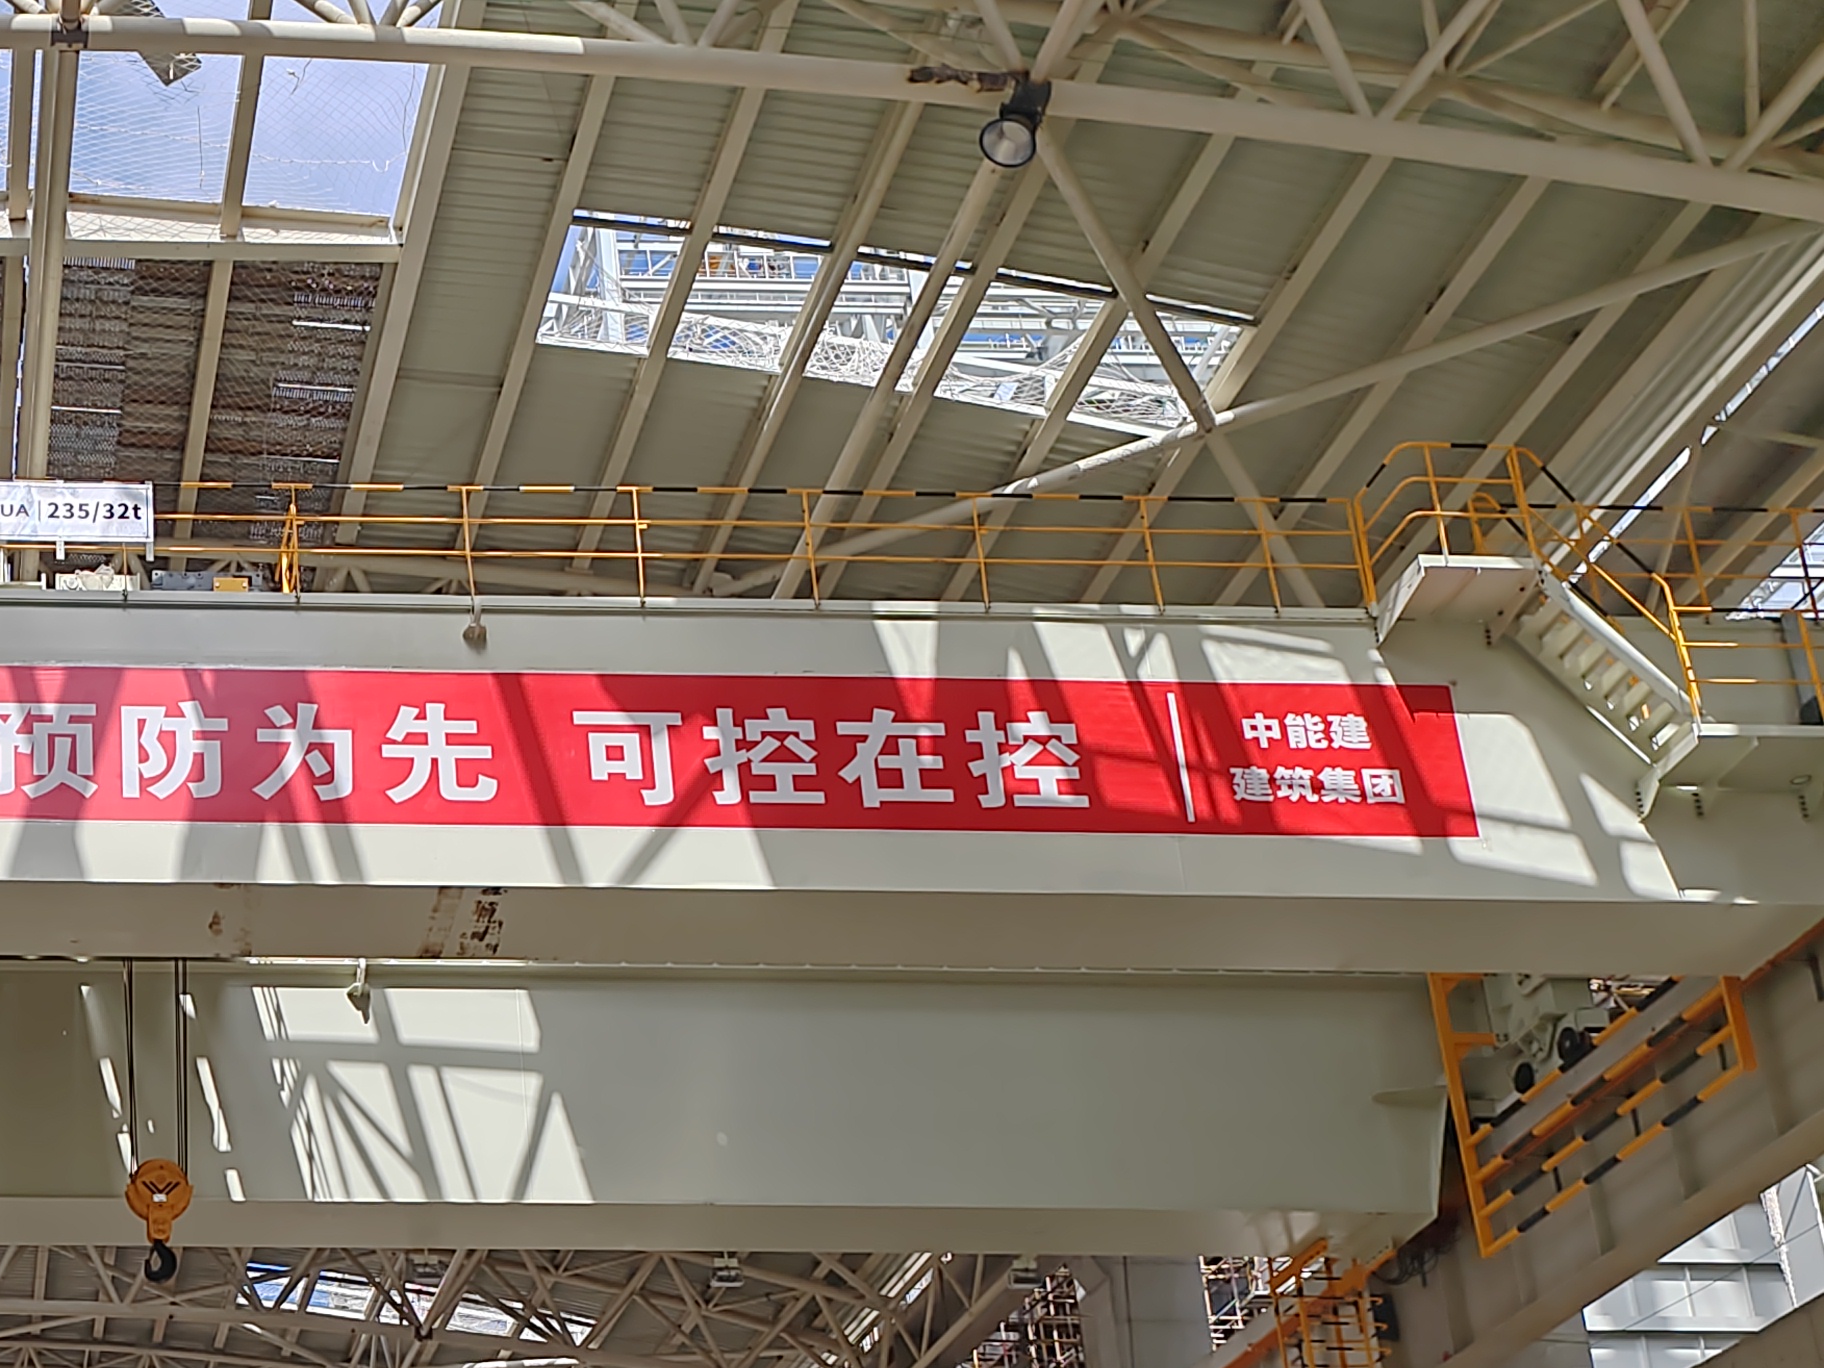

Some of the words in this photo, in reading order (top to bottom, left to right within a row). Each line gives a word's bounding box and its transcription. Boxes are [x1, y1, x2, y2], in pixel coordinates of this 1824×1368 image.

[47, 502, 143, 523] 235/32t
[1241, 712, 1373, 750] 中能建
[572, 707, 1090, 808] 可控在控
[1229, 765, 1406, 804] 建筑集团
